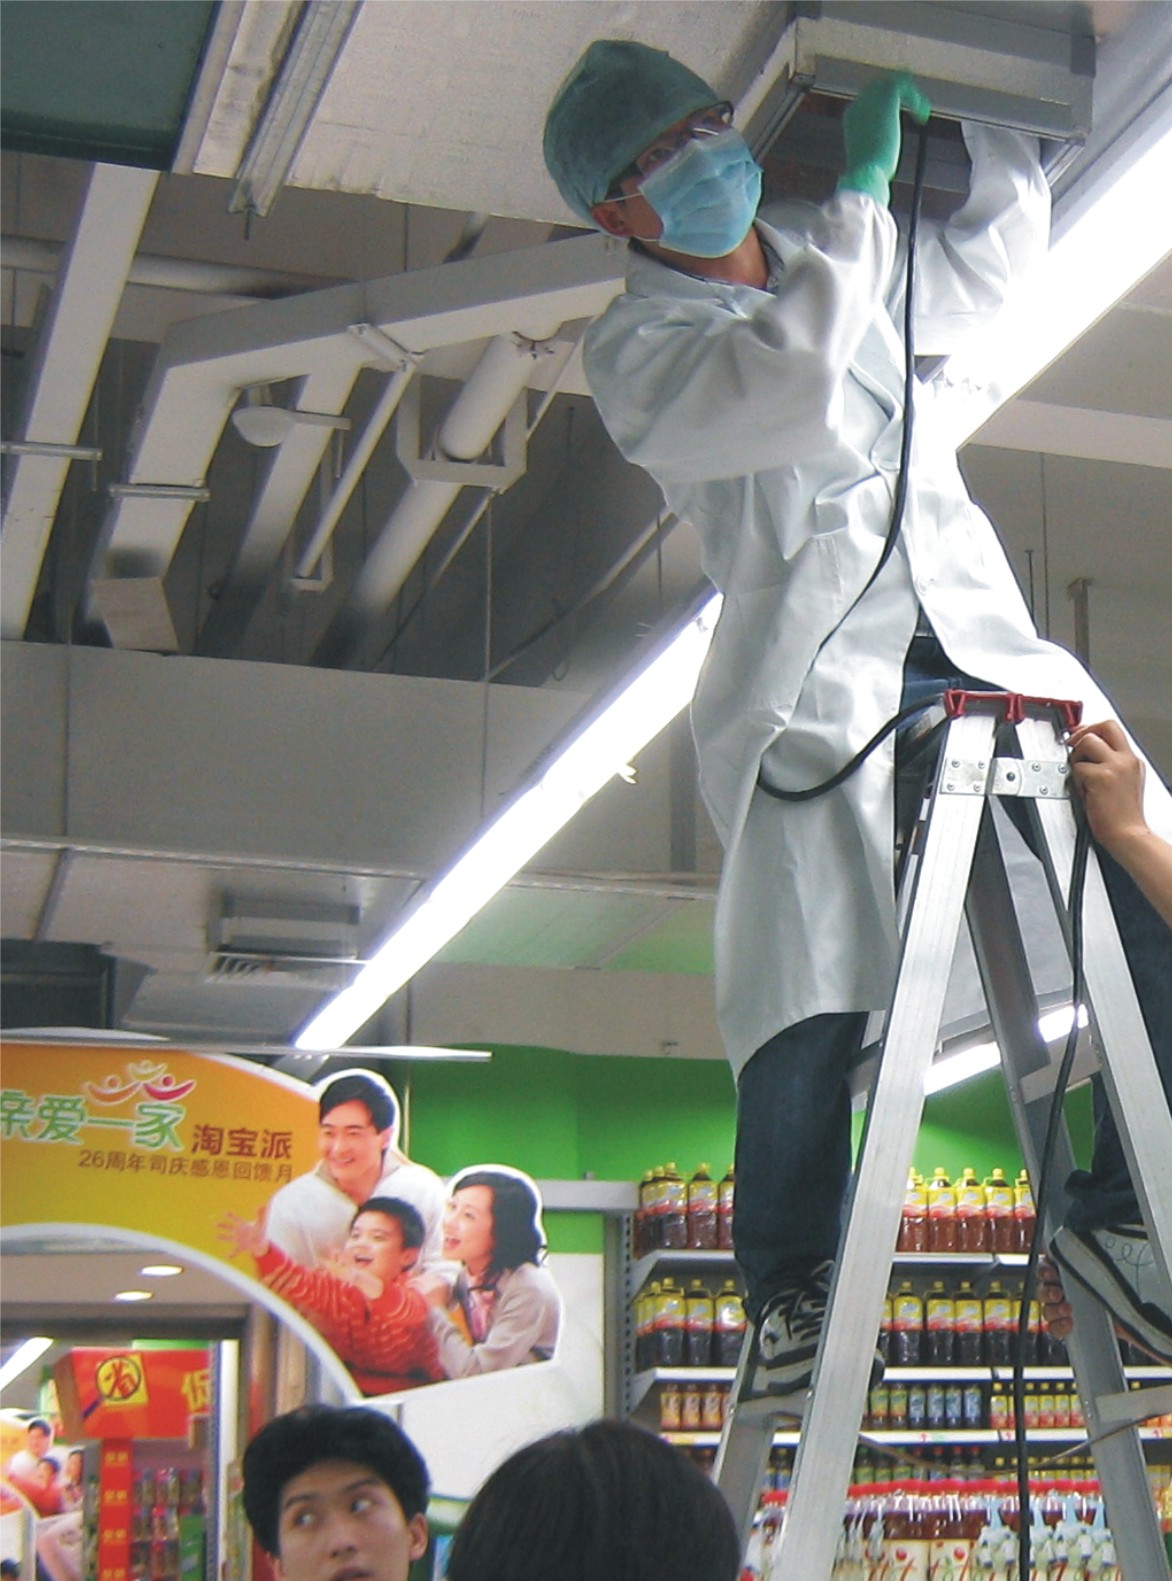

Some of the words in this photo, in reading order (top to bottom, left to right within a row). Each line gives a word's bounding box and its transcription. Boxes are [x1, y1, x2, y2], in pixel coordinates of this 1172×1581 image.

[0, 1090, 185, 1150] 亲爱一家
[192, 1123, 293, 1160] 淘宝派
